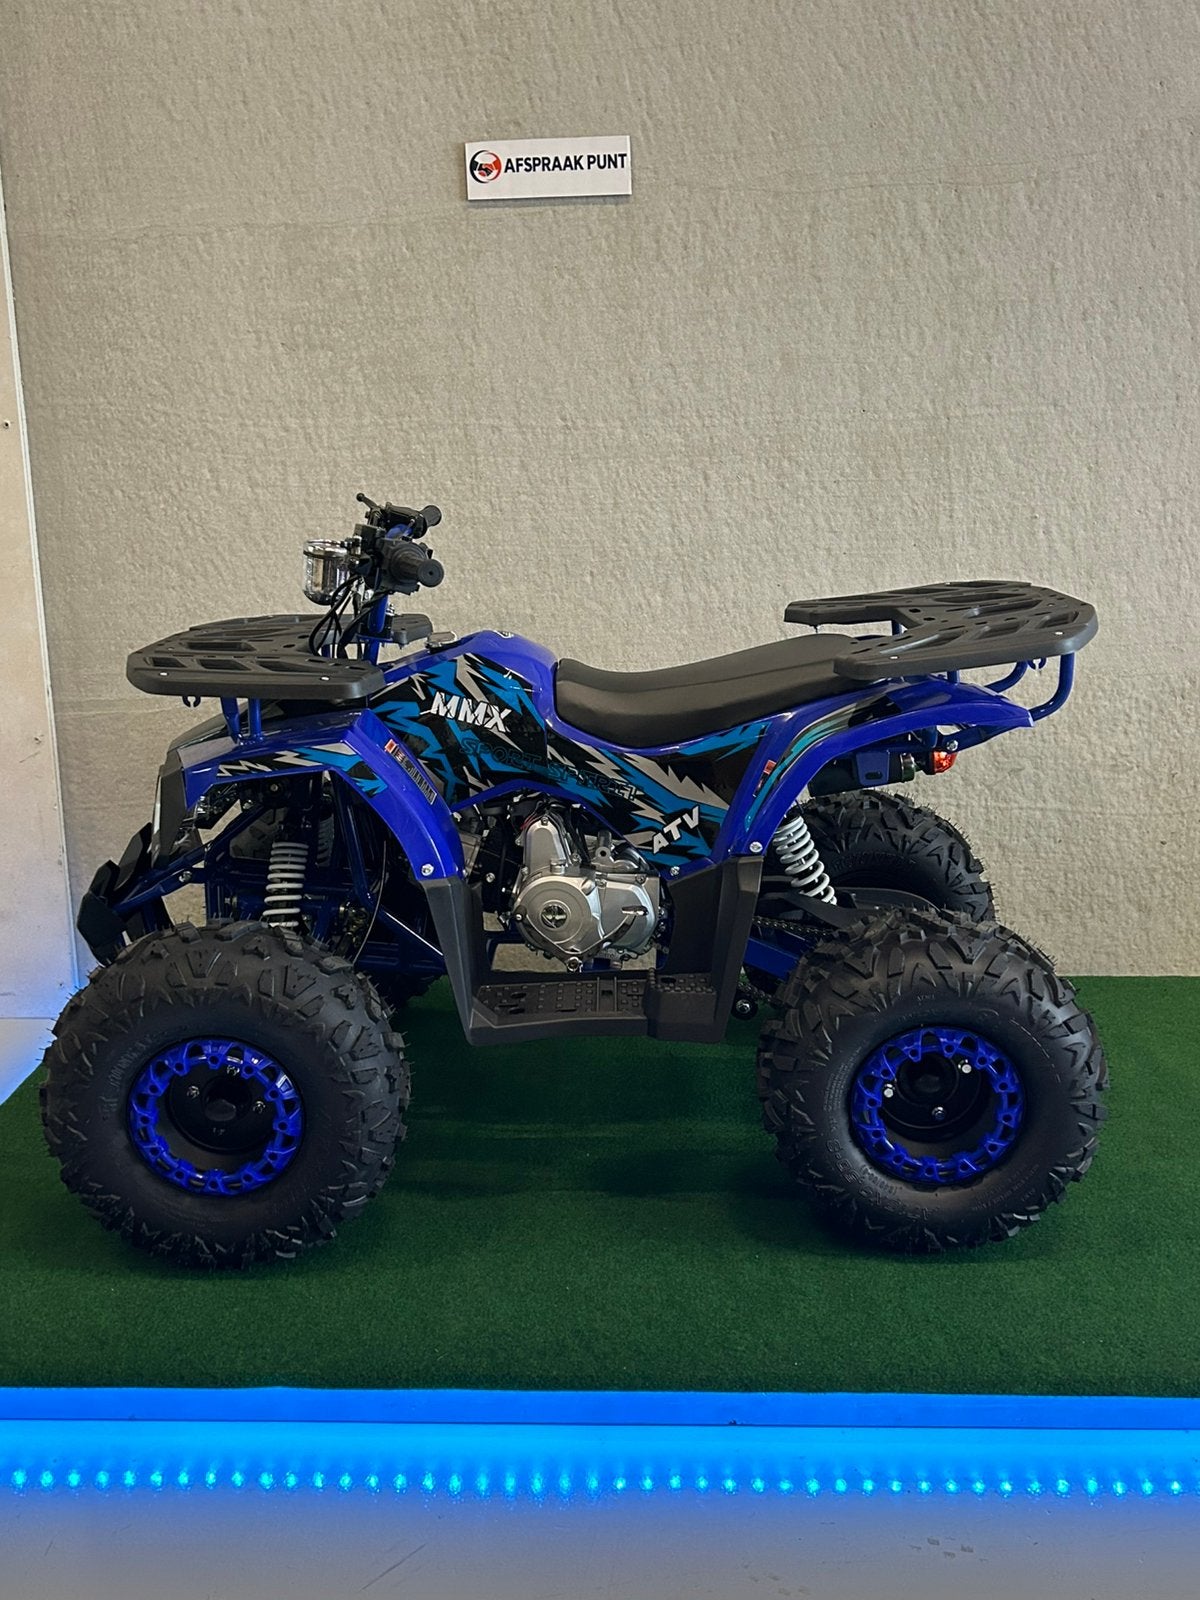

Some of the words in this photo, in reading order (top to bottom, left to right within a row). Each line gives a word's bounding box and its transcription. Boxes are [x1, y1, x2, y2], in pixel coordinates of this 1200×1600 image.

[504, 156, 584, 173] AFSPRAAK
[587, 153, 627, 170] PUNT
[430, 691, 512, 733] MMX
[459, 737, 543, 771] SPORT
[652, 806, 700, 854] ATV
